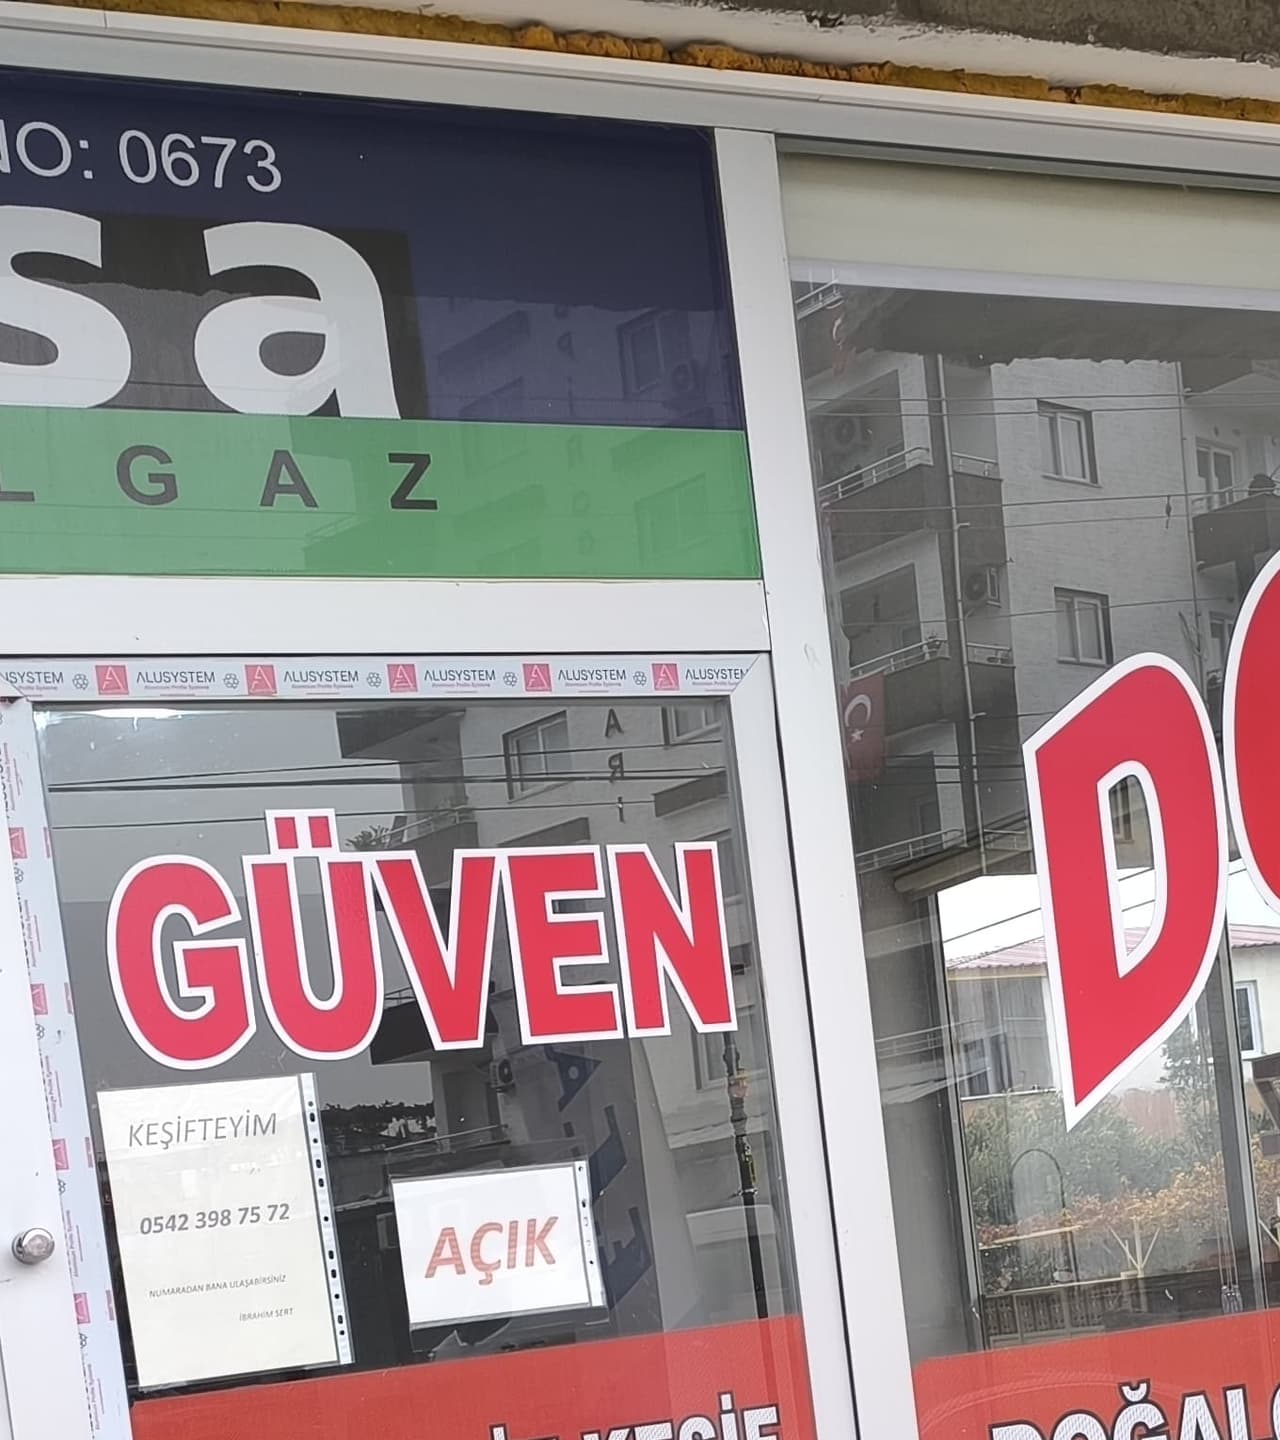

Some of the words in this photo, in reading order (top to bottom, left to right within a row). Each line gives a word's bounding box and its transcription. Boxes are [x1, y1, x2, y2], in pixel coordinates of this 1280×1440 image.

[118, 128, 284, 192] 0673
[136, 671, 216, 684] ALUSYSTEM
[283, 670, 359, 682] ALUSYSTEM
[423, 669, 496, 681] ALUSYSTEM
[558, 669, 627, 681] ALUSYSTEM
[106, 808, 738, 1070] GÜVEN
[128, 1108, 277, 1150] KEŞİFTEYİM
[140, 1211, 189, 1237] 0542
[195, 1207, 232, 1231] 398
[238, 1204, 261, 1226] 75
[267, 1202, 291, 1223] 72
[424, 1216, 559, 1286] AÇIK
